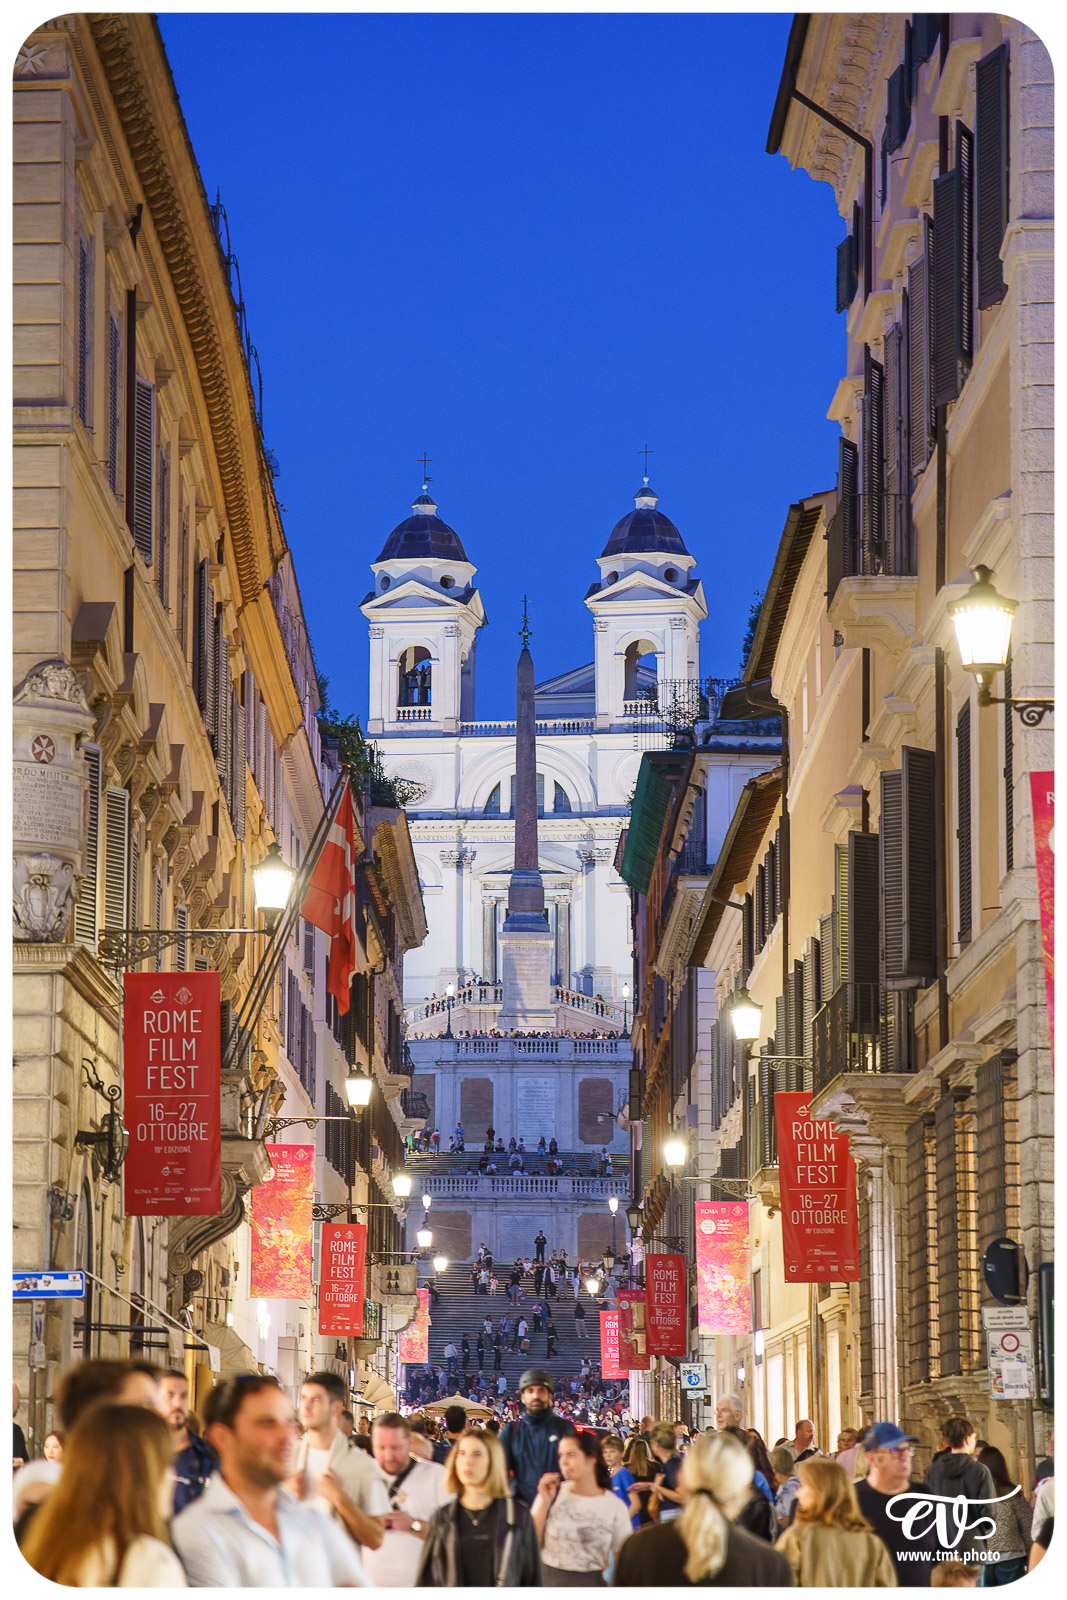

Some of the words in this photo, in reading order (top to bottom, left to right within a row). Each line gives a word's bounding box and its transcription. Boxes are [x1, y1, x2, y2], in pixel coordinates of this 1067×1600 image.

[143, 1009, 203, 1034] ROME
[148, 1037, 196, 1062] FILM
[147, 1065, 199, 1090] FEST
[137, 1122, 209, 1142] OTTOBRE
[791, 1121, 839, 1141] ROME
[797, 1143, 836, 1162] FILM
[796, 1165, 839, 1184] FEST
[791, 1209, 849, 1225] OTTOBRE
[330, 1240, 358, 1254] ROME
[331, 1253, 355, 1266] FILM
[330, 1266, 356, 1279] FEST
[653, 1269, 679, 1281] ROME
[655, 1281, 676, 1292] FILM
[325, 1292, 359, 1303] OTTOBRE
[654, 1292, 677, 1304] FEST
[605, 1321, 619, 1329] ROM
[650, 1316, 681, 1326] OTTOBRE
